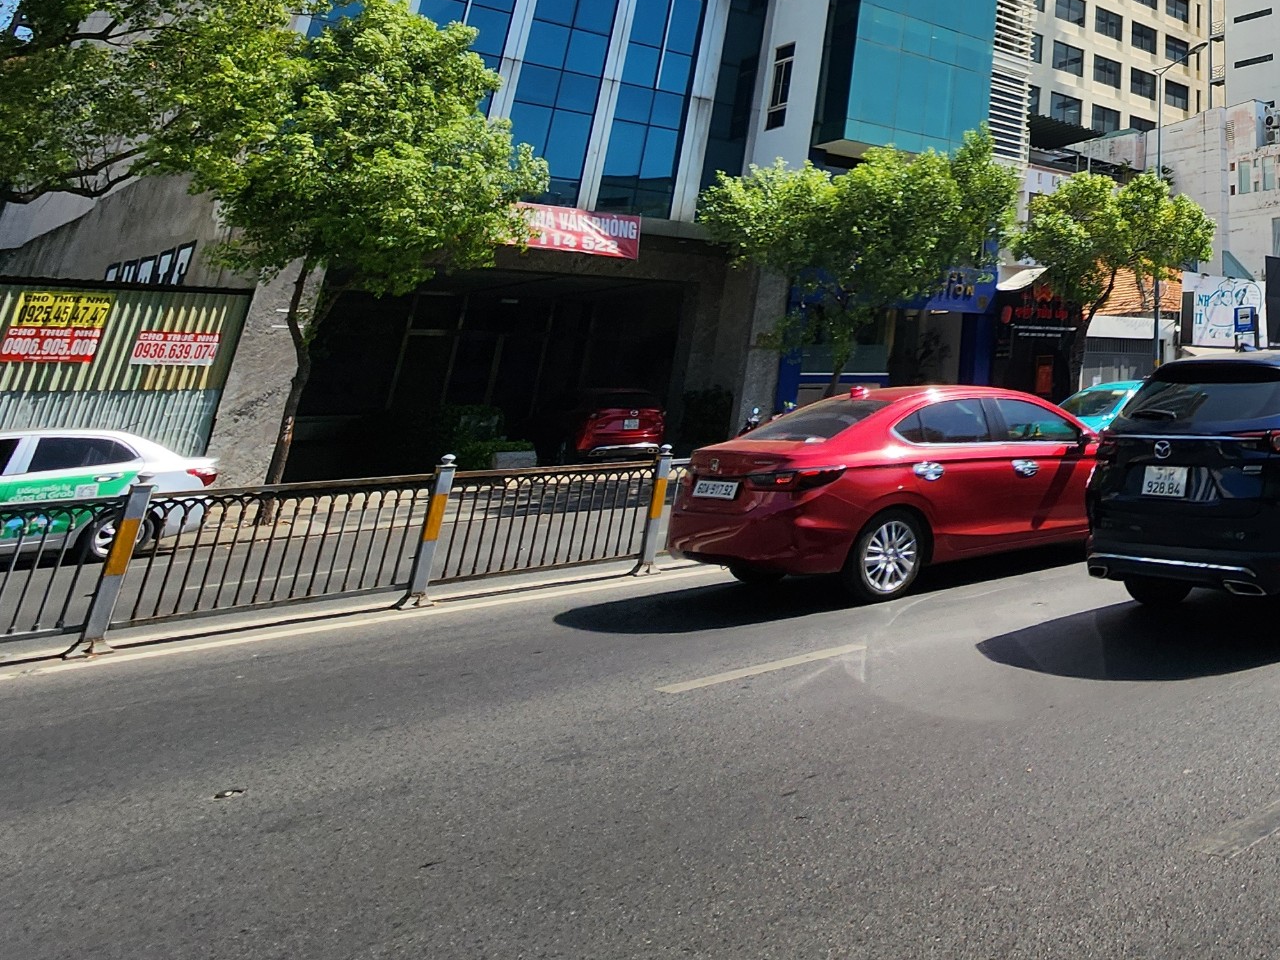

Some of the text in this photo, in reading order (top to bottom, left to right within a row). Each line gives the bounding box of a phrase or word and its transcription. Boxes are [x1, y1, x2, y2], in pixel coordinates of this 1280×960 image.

[24, 295, 50, 303] CHO
[8, 328, 101, 338] CHO THUÊ NHÀ
[140, 333, 164, 341] CHO
[166, 333, 195, 342] THUÊ
[2, 337, 98, 356] 0906.905.006
[134, 342, 215, 360] 0936.639.074
[1147, 480, 1180, 495] 928.84
